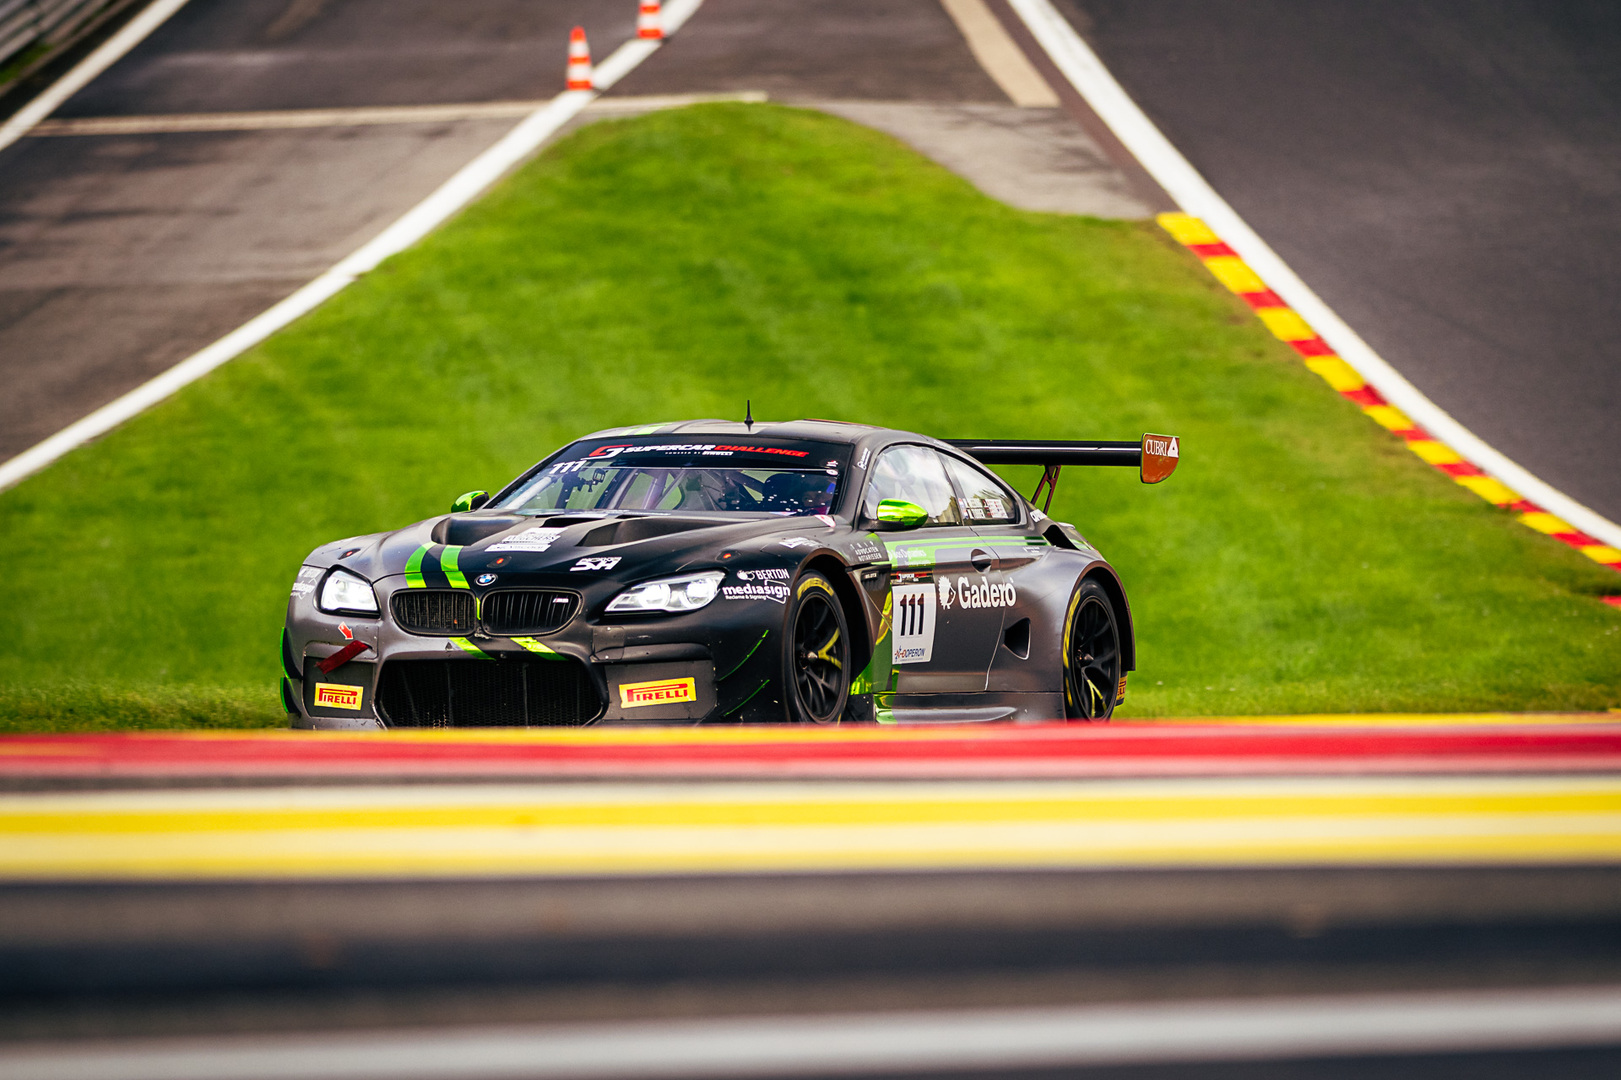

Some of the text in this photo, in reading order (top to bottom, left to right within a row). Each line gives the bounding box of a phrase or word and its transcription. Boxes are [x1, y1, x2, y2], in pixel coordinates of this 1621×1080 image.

[623, 444, 809, 458] SUPERCAR CHALLENGE
[549, 460, 587, 474] 111
[755, 568, 790, 580] BERTON
[722, 583, 791, 598] mediasign
[900, 593, 925, 636] 111
[318, 687, 358, 705] PIRELLI
[626, 683, 688, 702] PIRELLI
